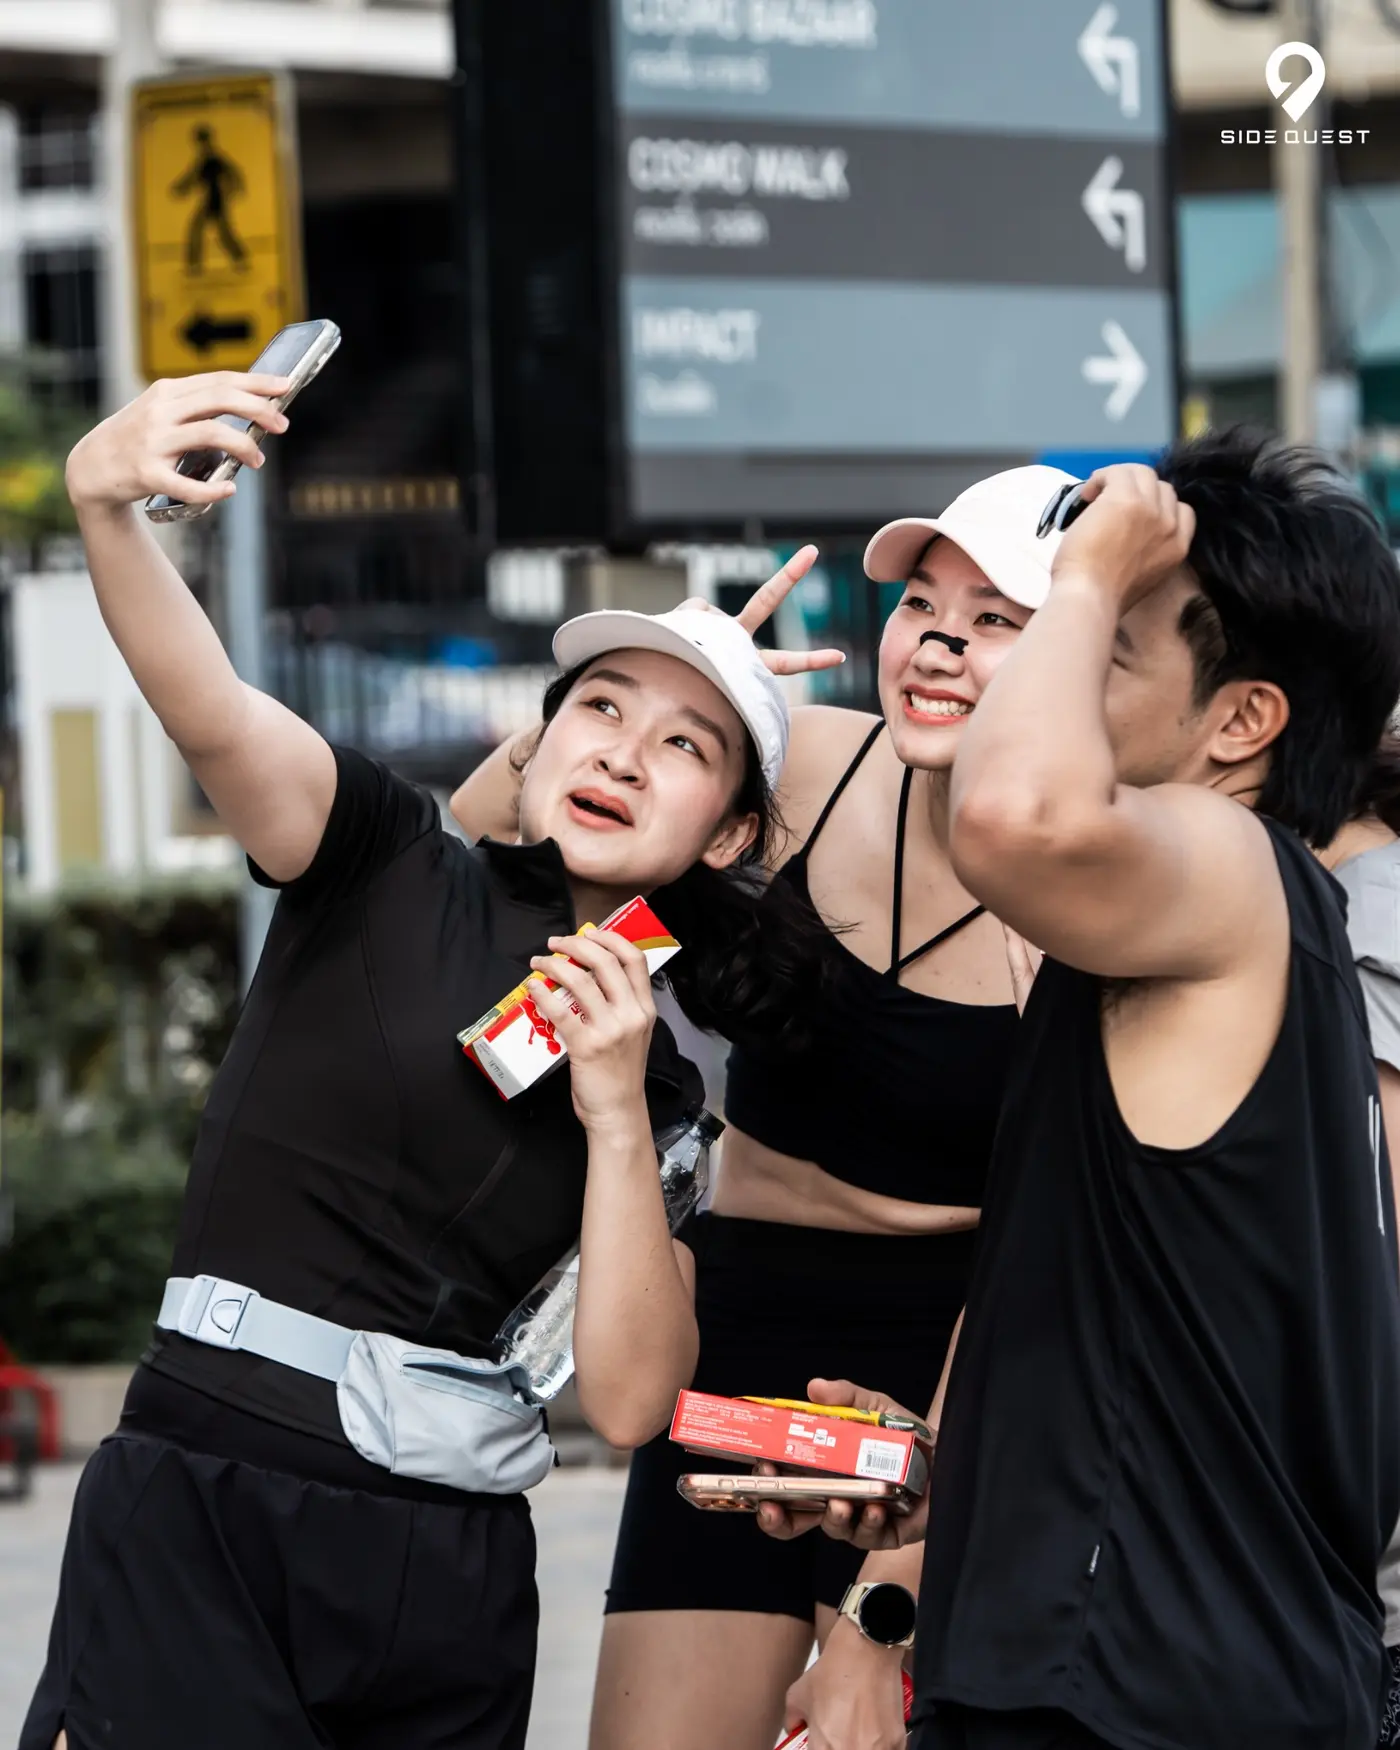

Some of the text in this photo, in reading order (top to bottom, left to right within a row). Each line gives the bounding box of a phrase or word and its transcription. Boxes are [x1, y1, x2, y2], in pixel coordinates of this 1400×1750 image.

[629, 138, 848, 199] COSMO WALK
[639, 309, 758, 361] IMPACT
